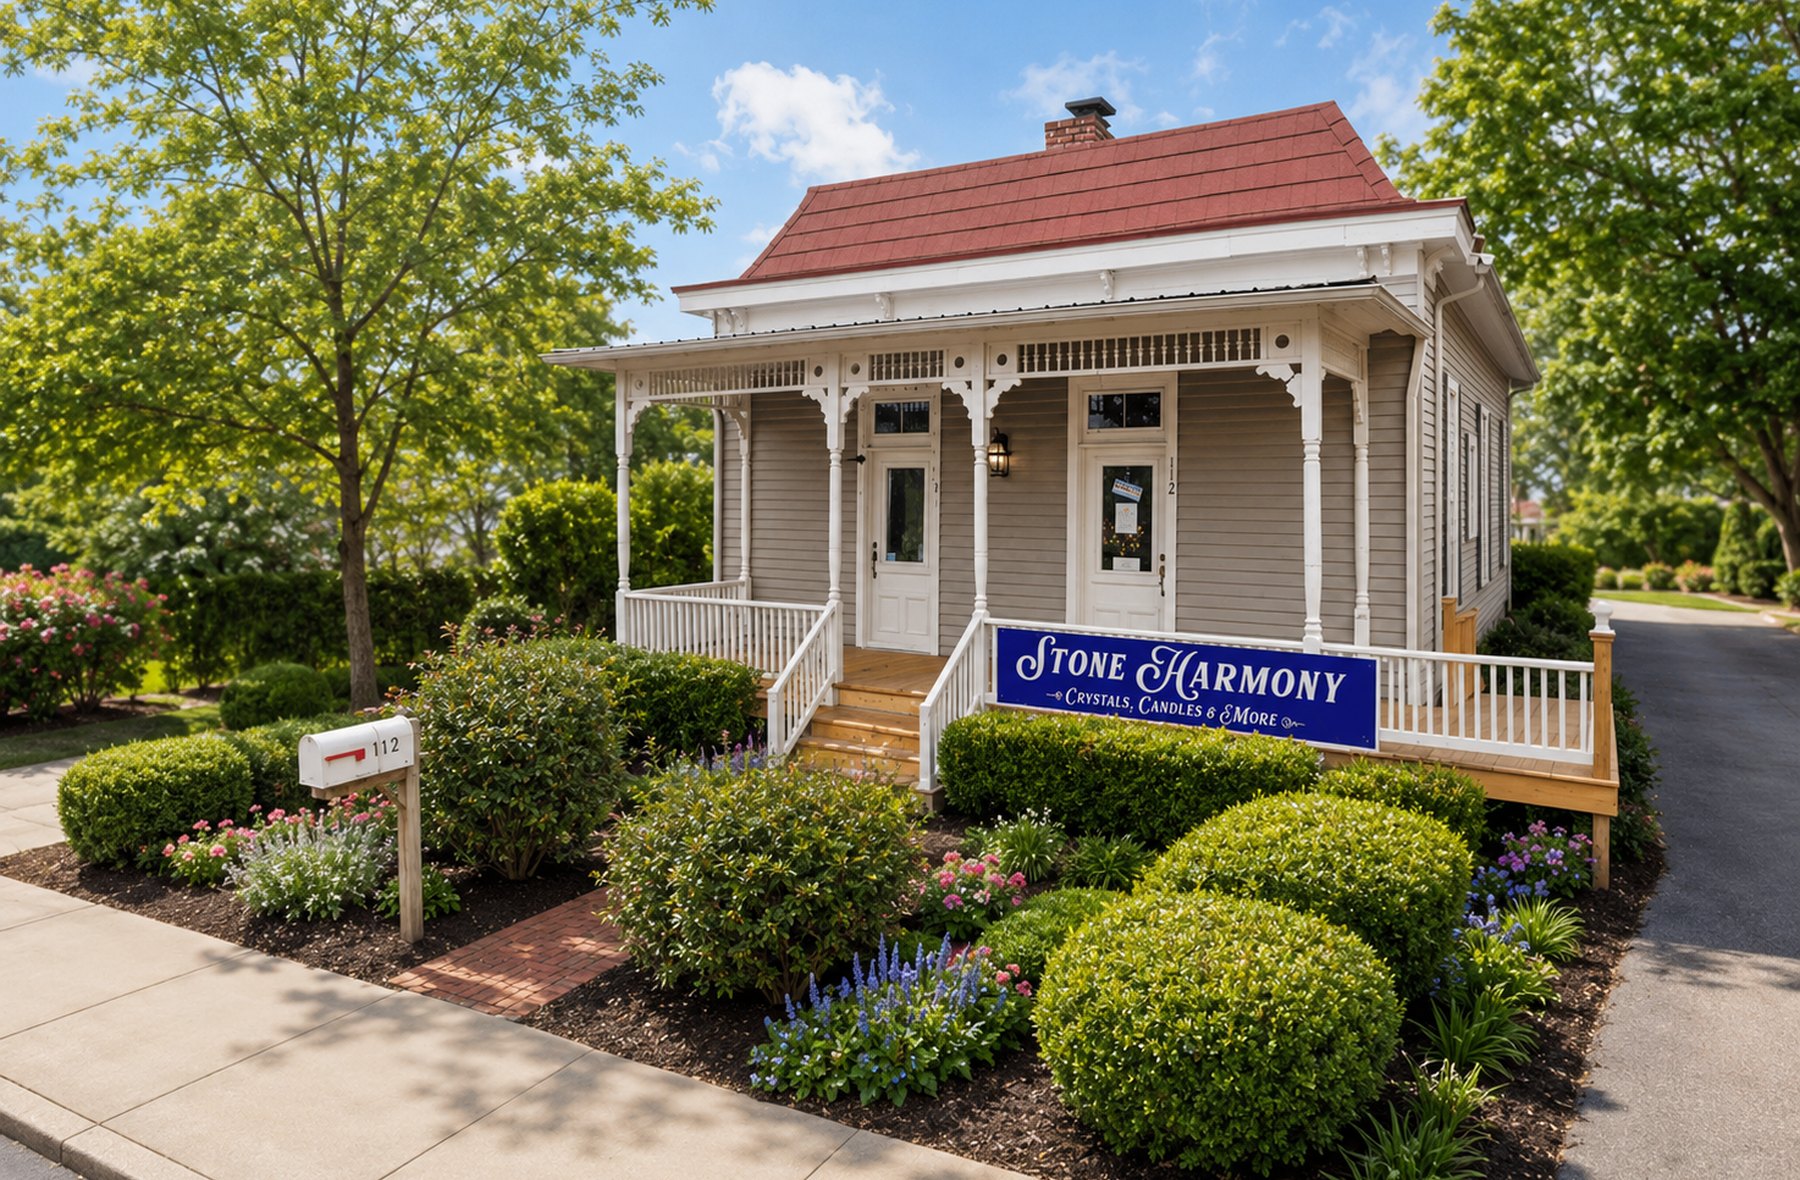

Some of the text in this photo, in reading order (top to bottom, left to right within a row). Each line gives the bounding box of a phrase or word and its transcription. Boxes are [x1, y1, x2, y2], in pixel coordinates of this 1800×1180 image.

[1015, 635, 1347, 704] STONE HARMONY
[1138, 695, 1203, 718] CANDLES
[372, 736, 399, 757] 112
